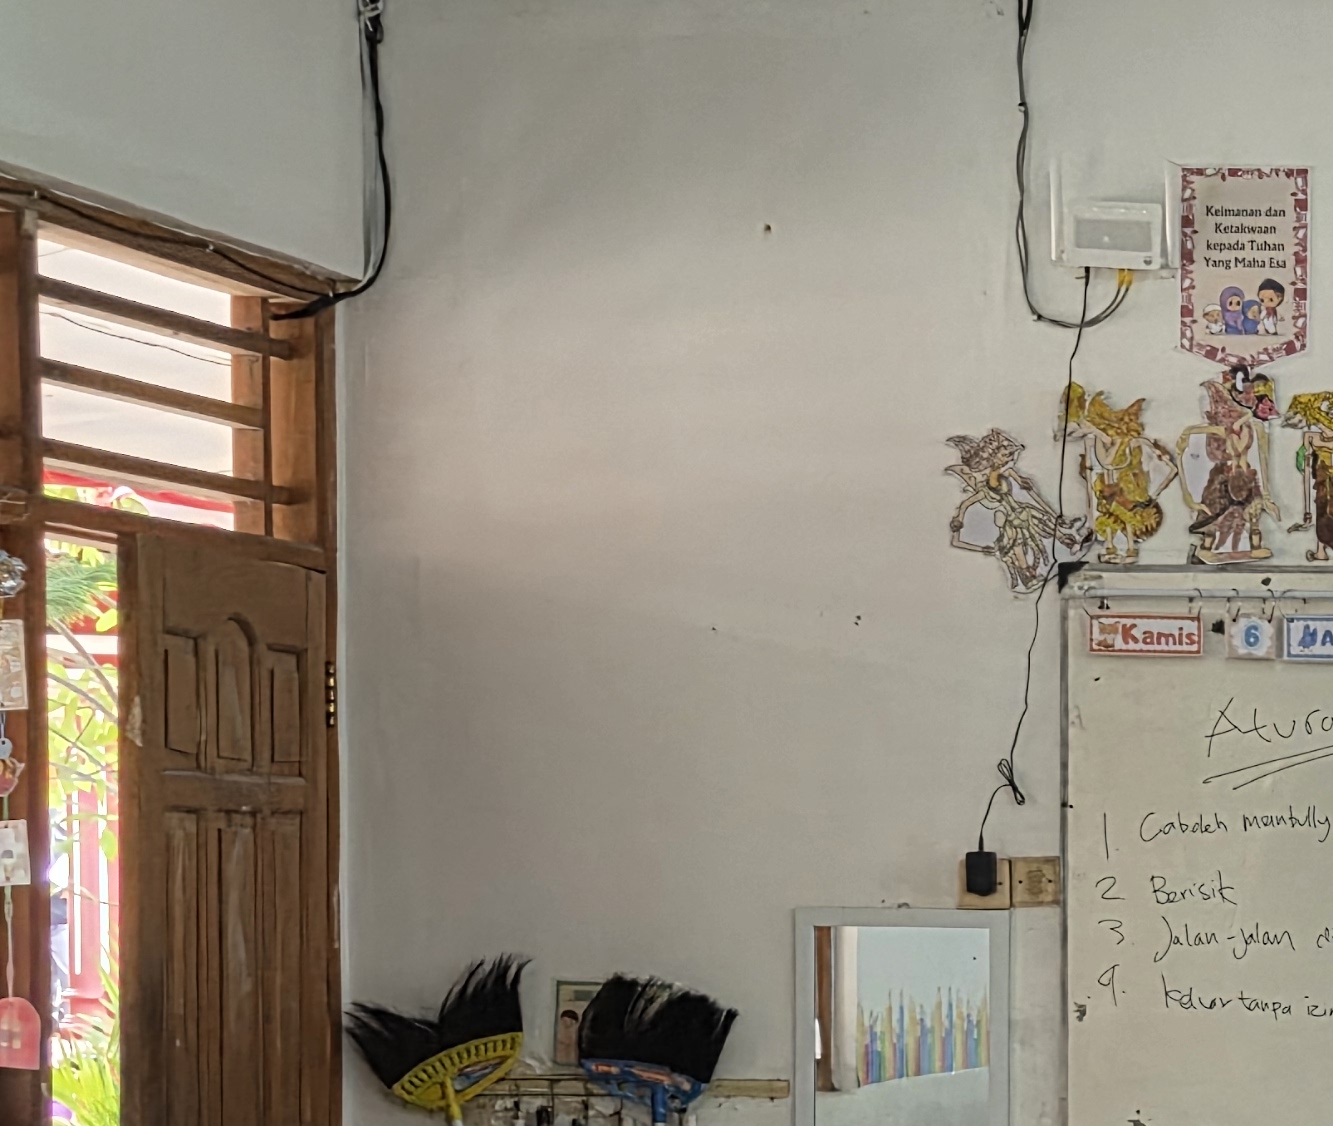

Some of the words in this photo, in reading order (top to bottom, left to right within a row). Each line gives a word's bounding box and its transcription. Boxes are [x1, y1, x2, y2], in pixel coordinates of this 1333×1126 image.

[1266, 206, 1286, 217] dan
[1206, 240, 1245, 252] kepada
[1249, 240, 1284, 251] Tuhan
[1204, 256, 1232, 269] Yang
[1235, 257, 1266, 268] Maha
[1269, 258, 1286, 268] Esa
[1121, 623, 1198, 646] Kamis
[1244, 625, 1259, 648] 6
[1095, 876, 1126, 901] 2
[1149, 870, 1238, 905] Berisik
